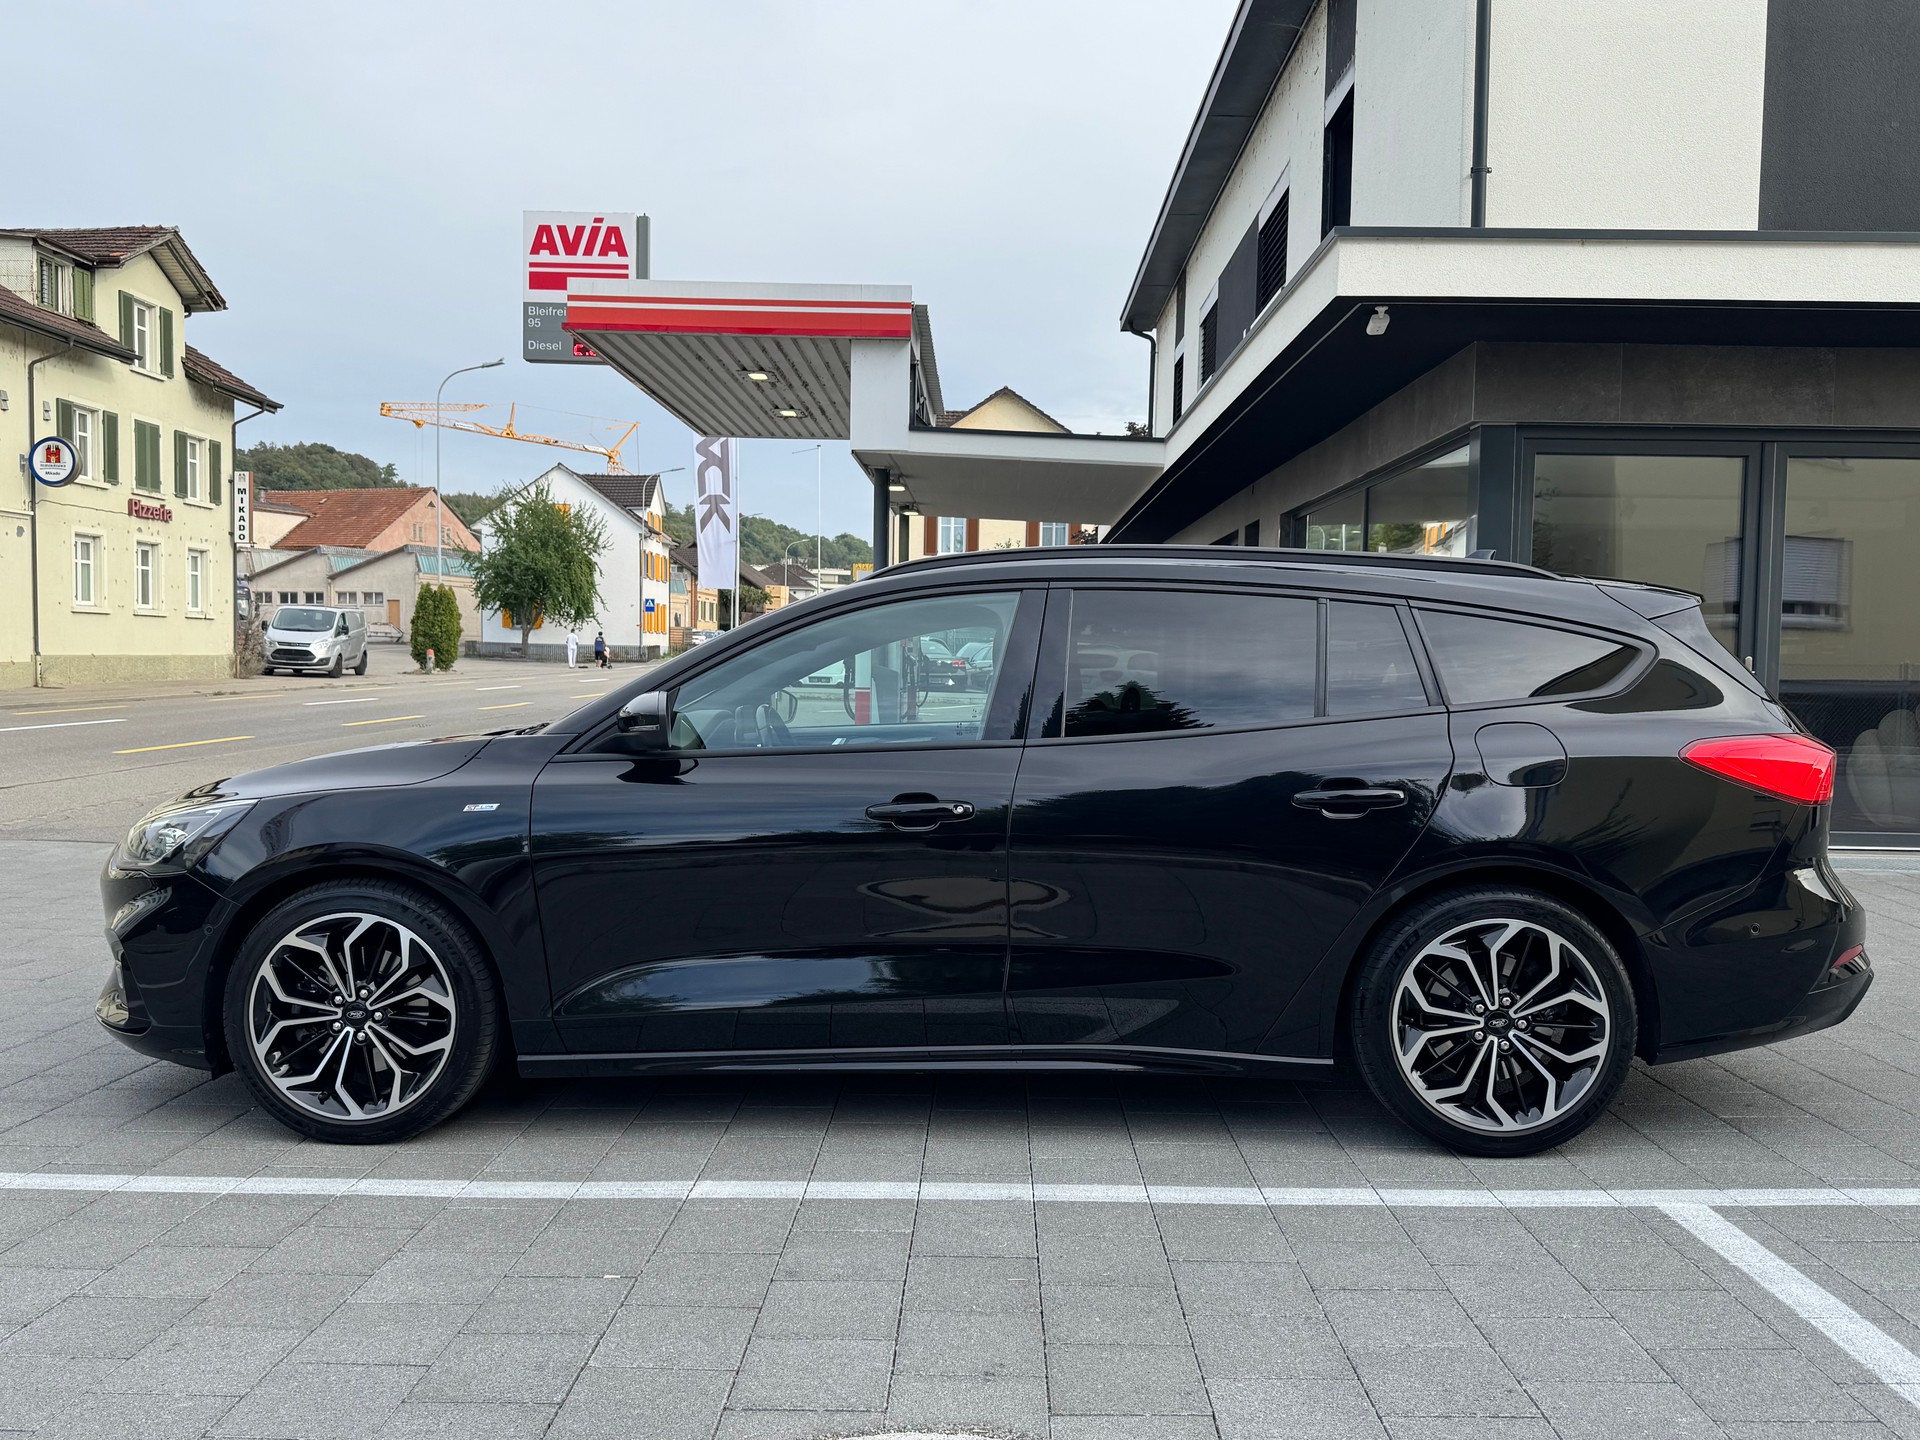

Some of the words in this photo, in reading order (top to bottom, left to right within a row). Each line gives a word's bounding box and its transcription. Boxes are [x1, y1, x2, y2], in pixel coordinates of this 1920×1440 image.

[528, 306, 567, 317] Bleifrei
[527, 318, 541, 328] 95
[528, 340, 562, 351] Diesel
[130, 498, 173, 522] Pizzeria
[237, 487, 247, 541] MIKADO
